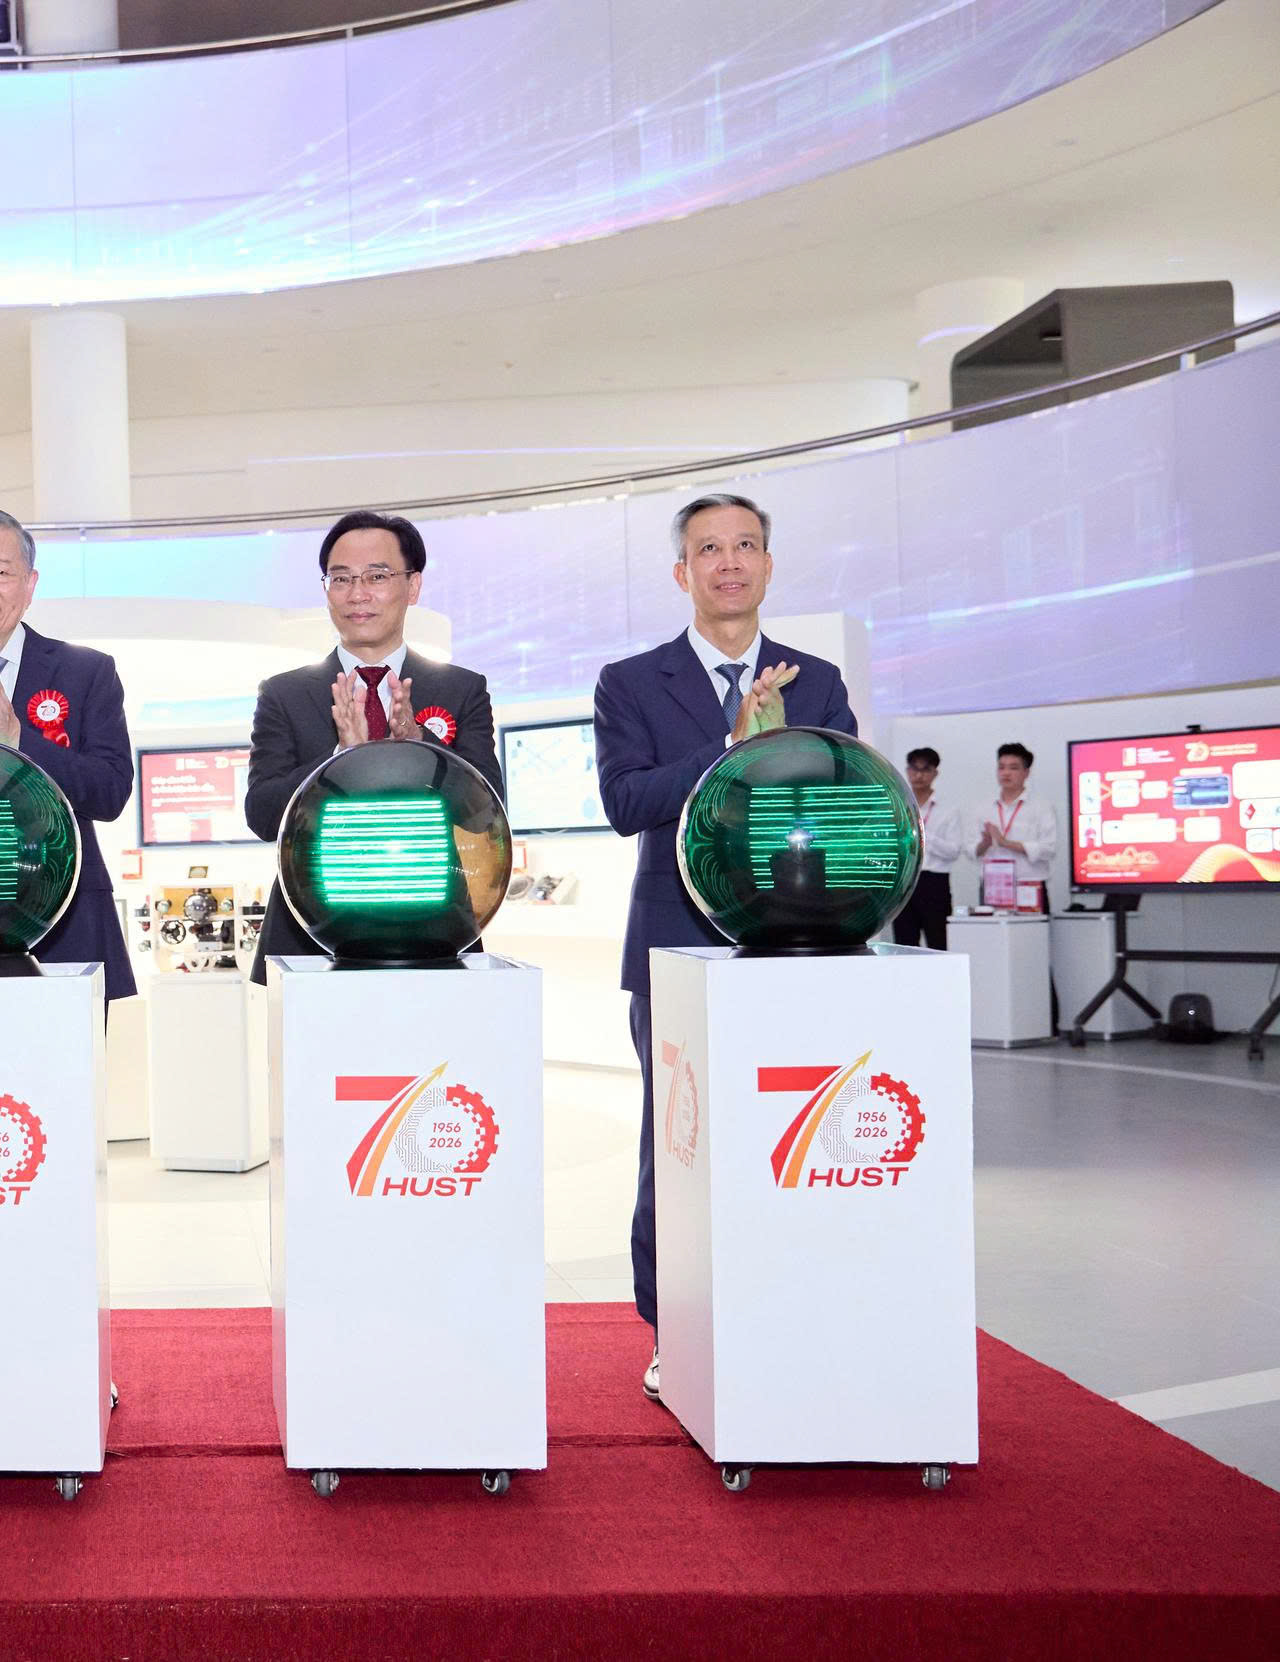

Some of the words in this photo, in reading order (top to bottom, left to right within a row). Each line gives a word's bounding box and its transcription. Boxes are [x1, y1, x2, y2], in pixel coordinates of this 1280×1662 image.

[857, 1112, 887, 1122] 1956
[432, 1122, 461, 1133] 1956
[854, 1127, 888, 1138] 2026
[428, 1137, 462, 1148] 2026
[808, 1167, 909, 1188] HUST
[382, 1177, 482, 1197] HUST
